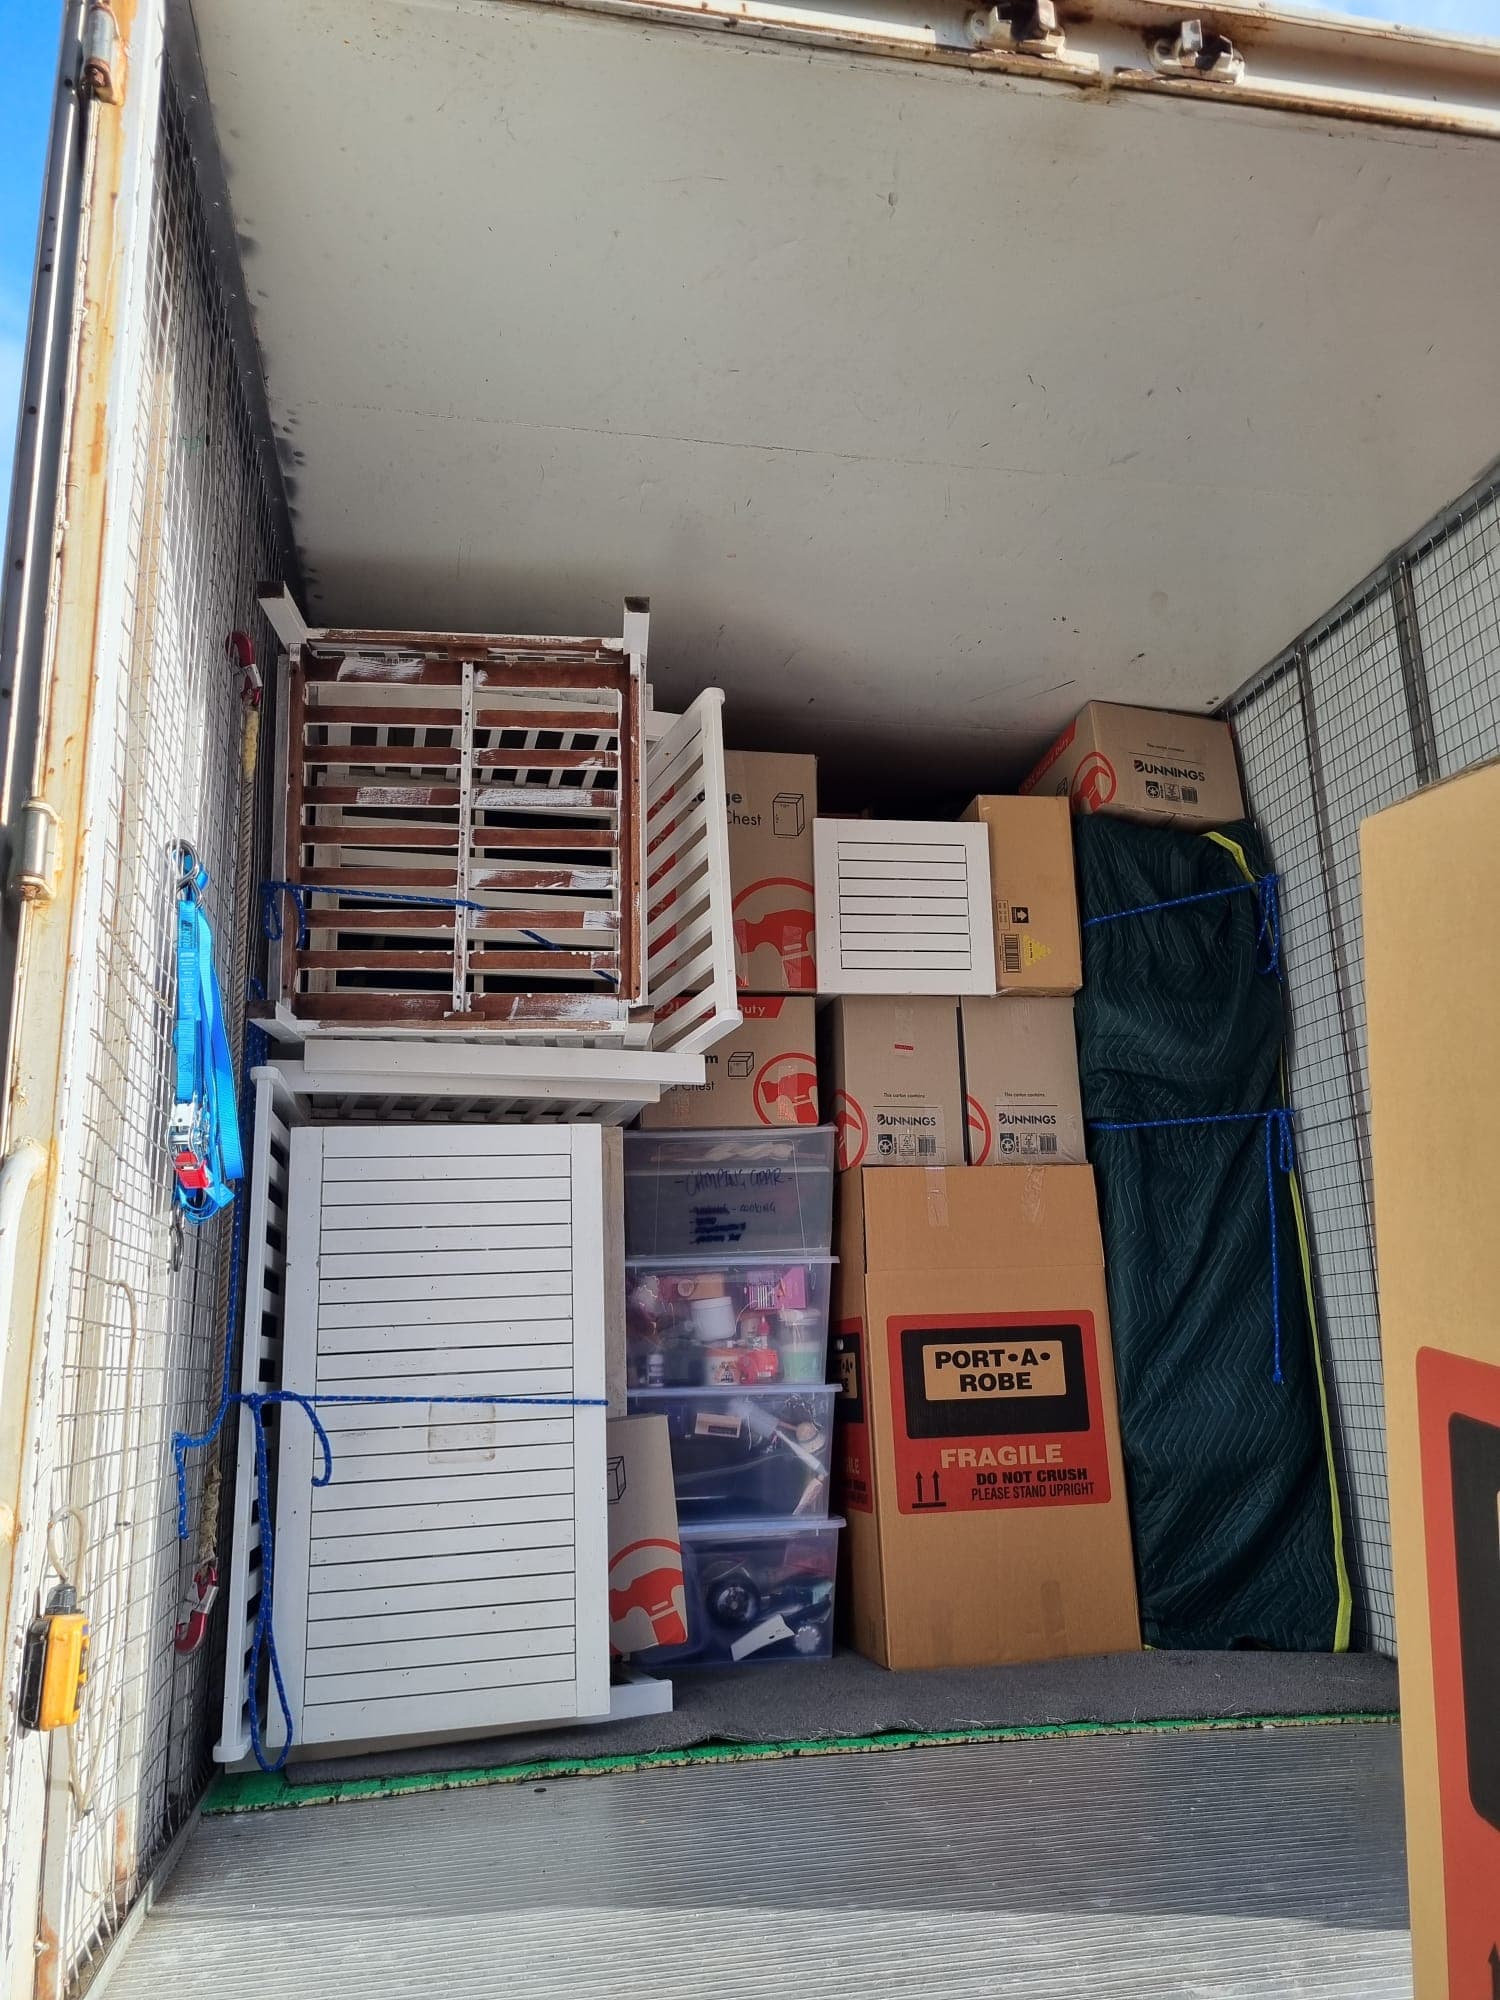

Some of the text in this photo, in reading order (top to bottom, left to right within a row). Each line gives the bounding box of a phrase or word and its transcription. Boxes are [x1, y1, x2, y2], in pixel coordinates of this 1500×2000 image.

[1134, 759, 1206, 781] BUNNINGS
[877, 1113, 936, 1126] BUNNINGS
[998, 1112, 1057, 1124] BUNNINGS
[959, 1372, 1033, 1392] ROBE
[940, 1444, 1064, 1469] FRAGILE
[976, 1468, 1088, 1485] DO NOT CRUSH
[971, 1481, 1095, 1500] PLEASE STAND UPRIGHT
